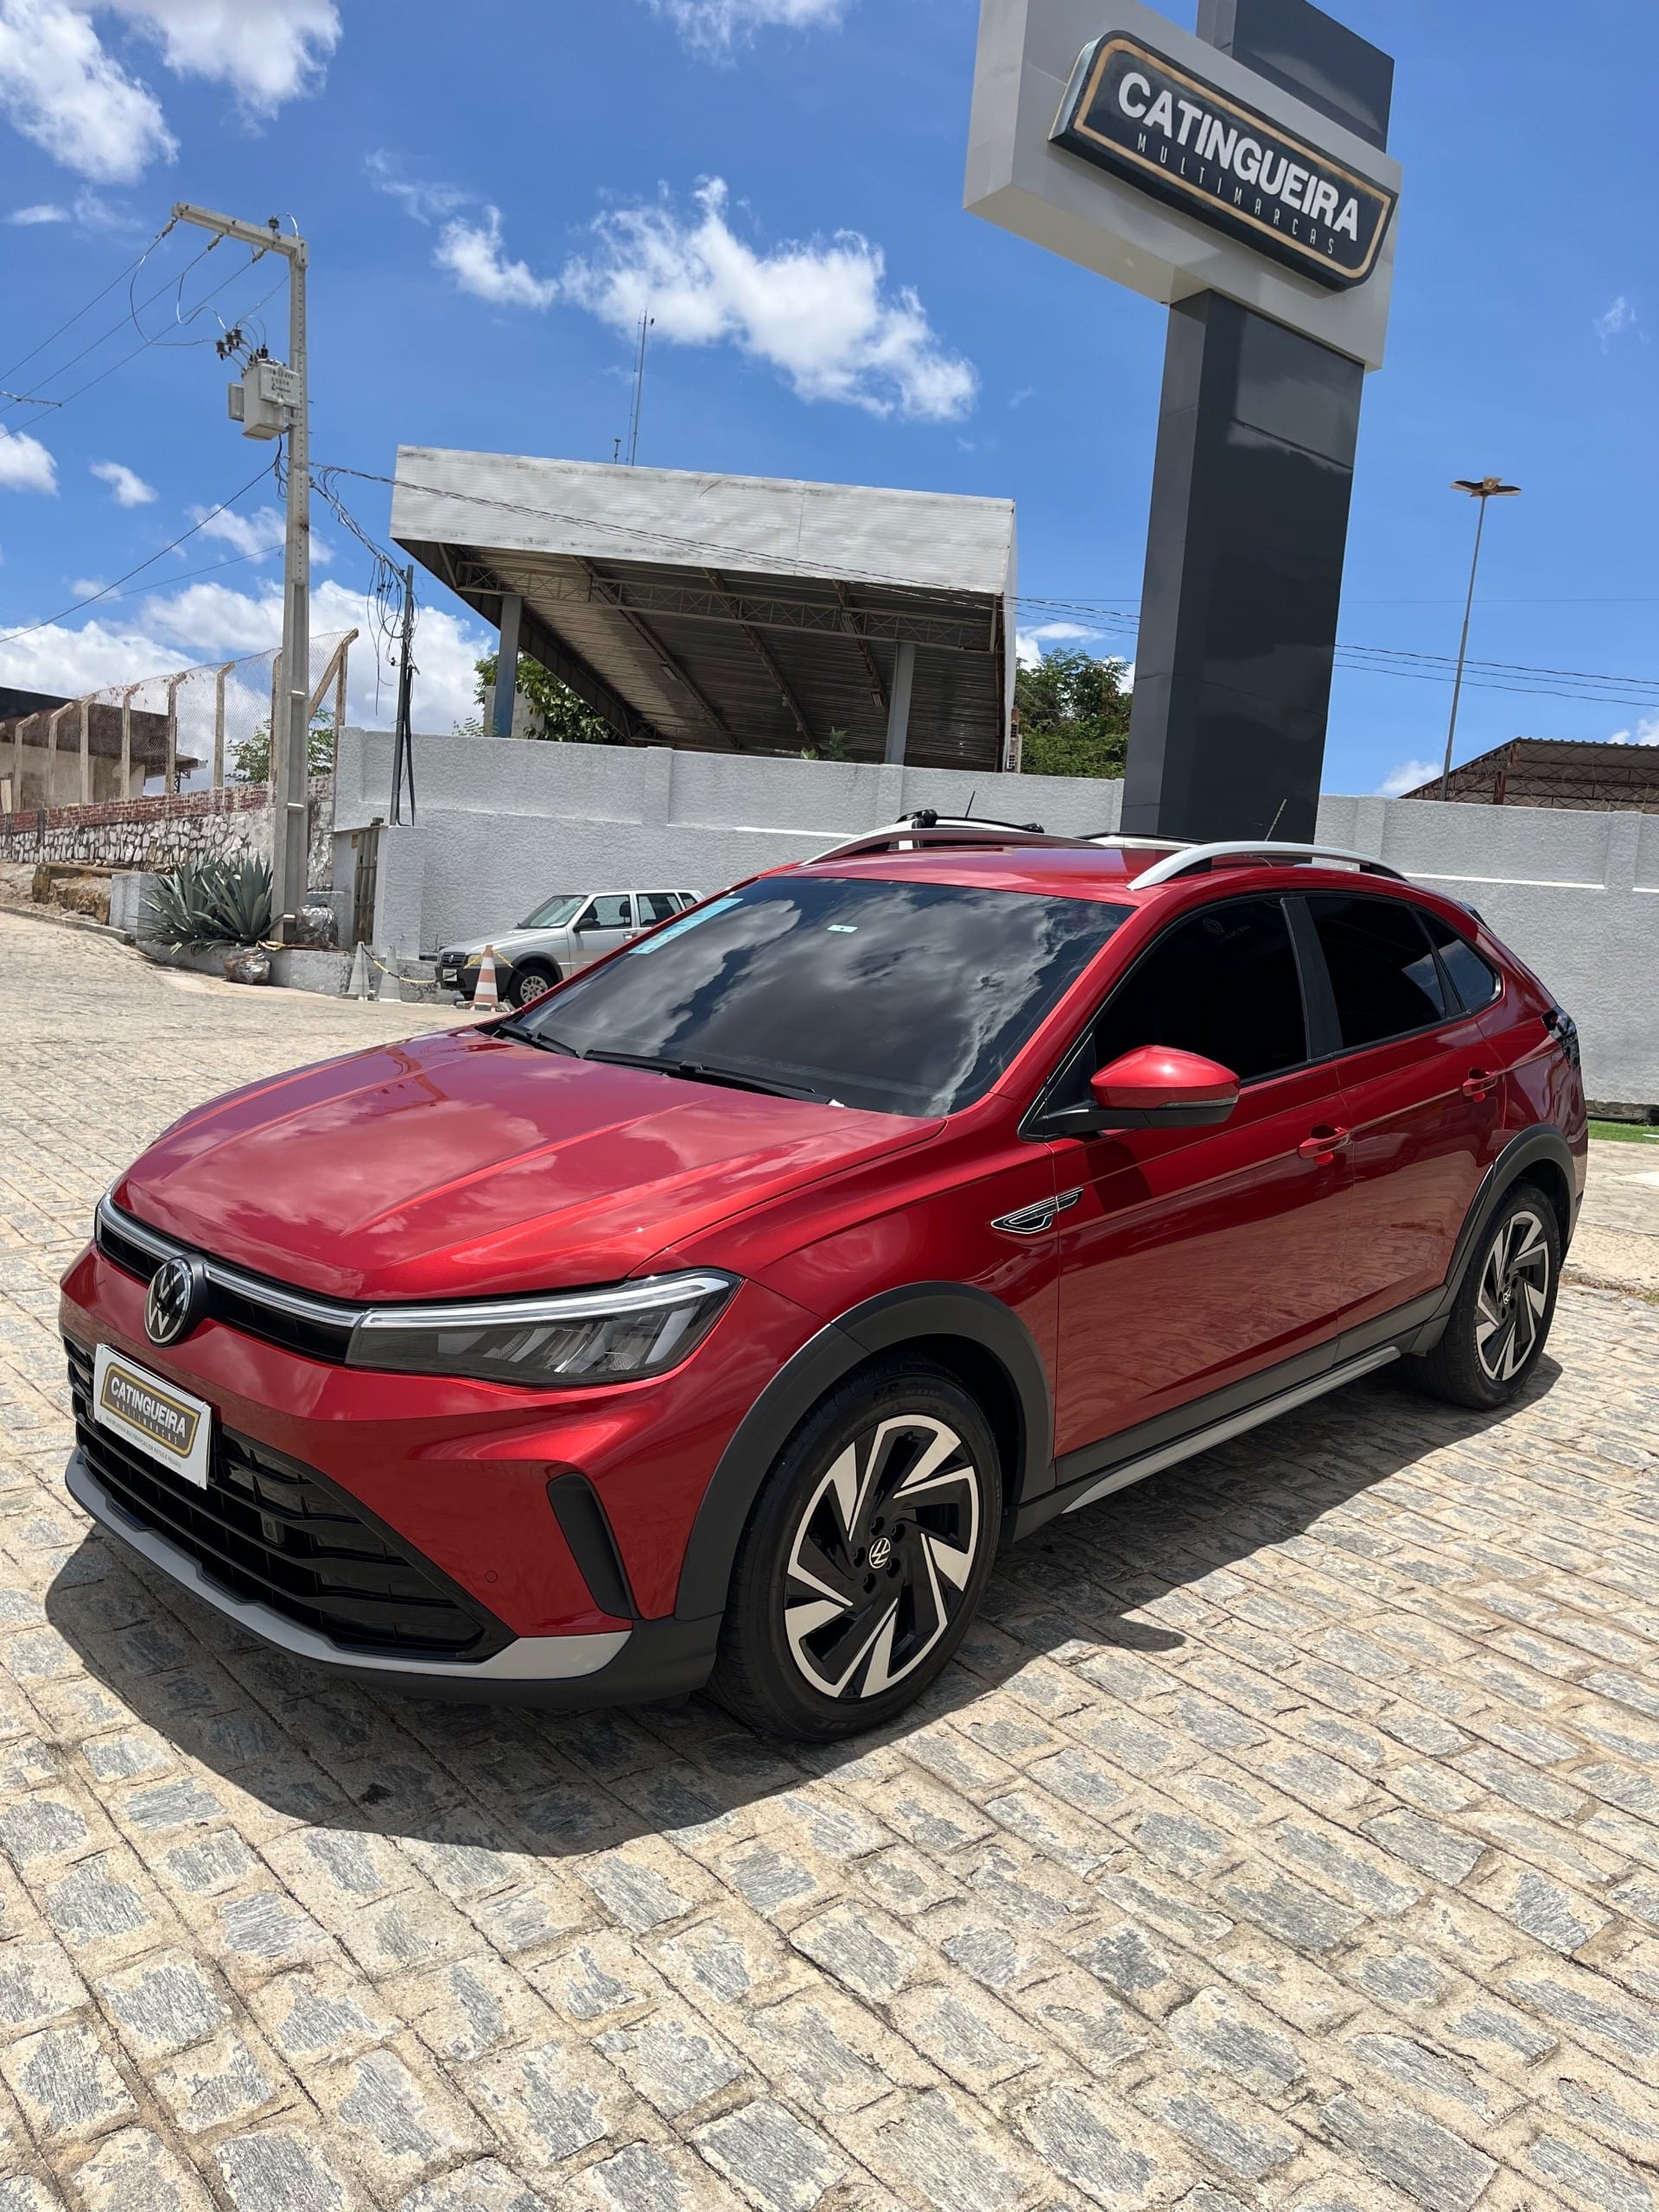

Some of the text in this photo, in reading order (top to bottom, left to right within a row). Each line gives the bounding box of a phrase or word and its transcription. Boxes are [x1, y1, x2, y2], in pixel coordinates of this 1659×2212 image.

[1118, 72, 1358, 242] CATINGUEIRA
[1137, 132, 1334, 255] MULTIMARCAS
[111, 1376, 186, 1439] CATINGUEIRA
